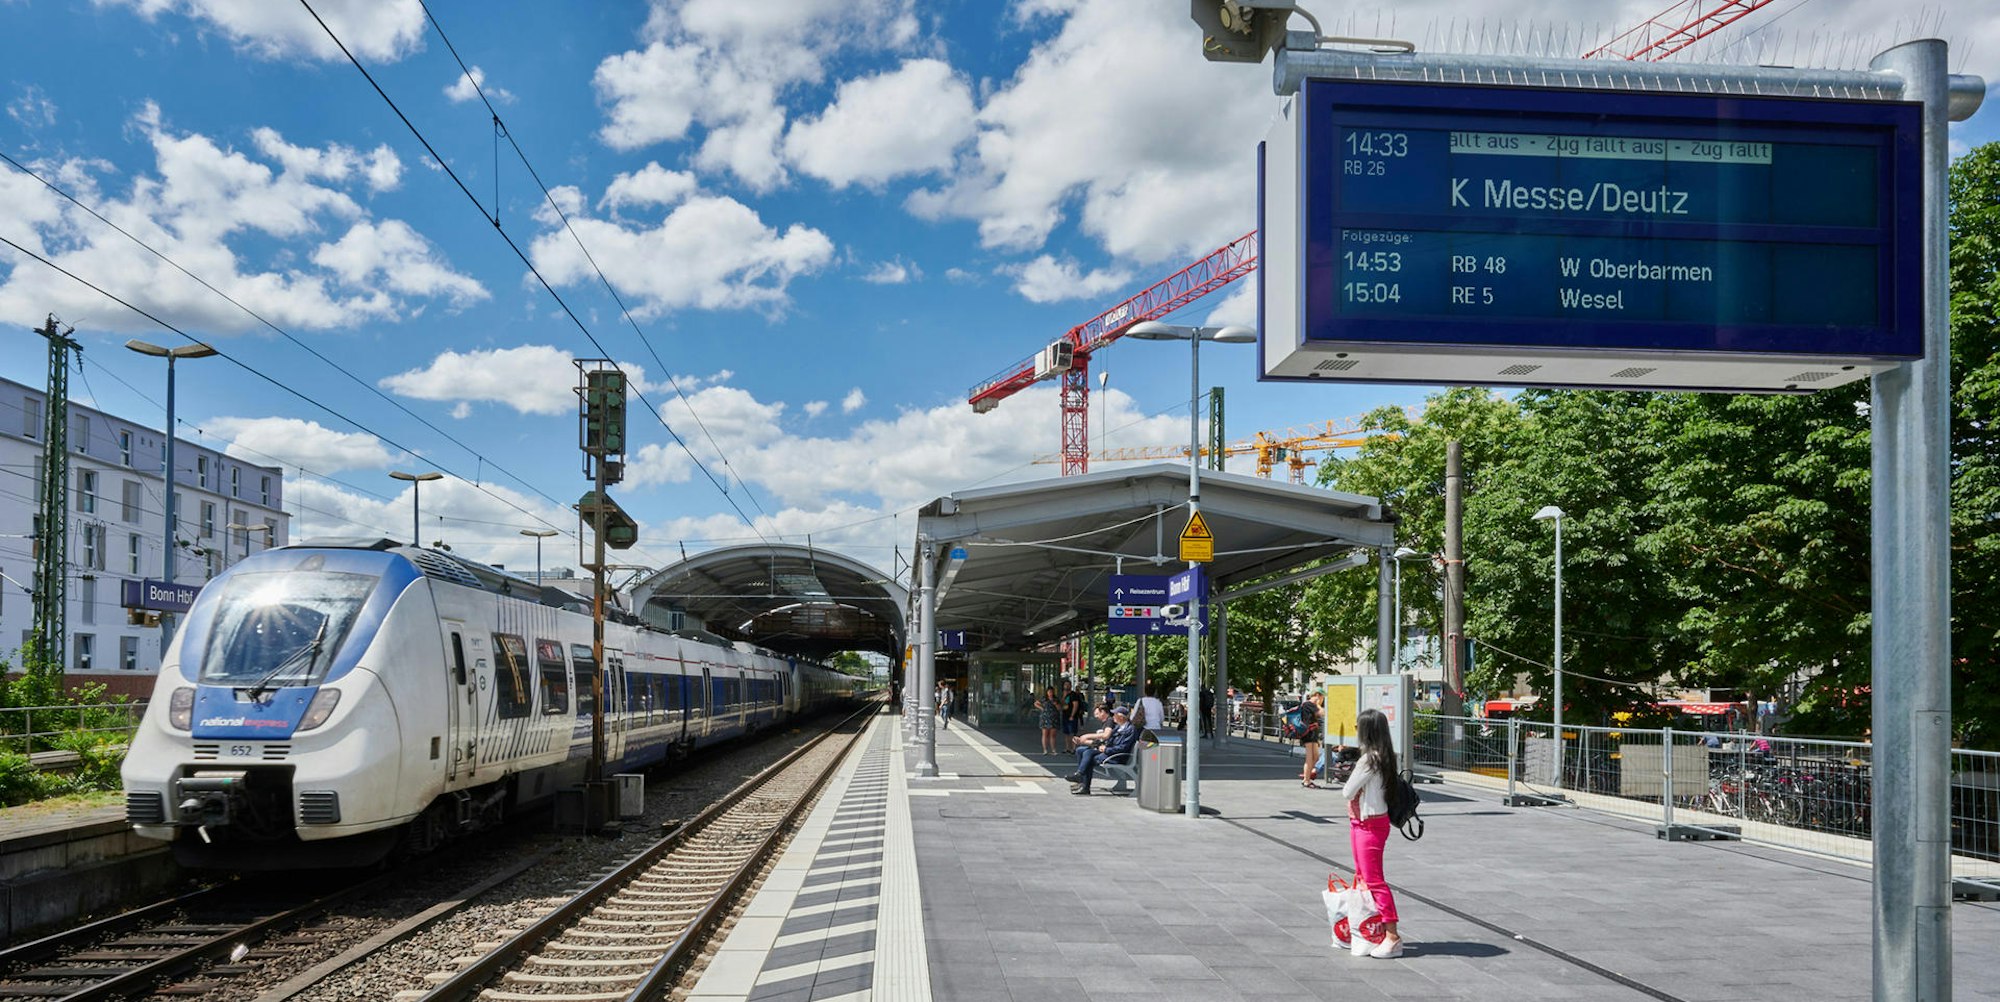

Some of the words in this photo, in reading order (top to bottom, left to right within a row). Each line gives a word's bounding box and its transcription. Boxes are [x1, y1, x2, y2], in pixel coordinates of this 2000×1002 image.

[1346, 131, 1408, 157] 14:33
[1488, 136, 1519, 149] aus
[1545, 136, 1579, 155] Zug
[1632, 141, 1664, 154] aus
[1691, 141, 1722, 160] Zug
[1344, 160, 1362, 175] RB
[1367, 161, 1385, 176] 26
[1452, 178, 1471, 207] K
[1484, 179, 1689, 215] Messe/Deutz
[1342, 229, 1413, 245] Folgezüge:
[1344, 251, 1401, 272] 14:53
[1453, 255, 1477, 273] RB
[1484, 256, 1506, 274] 48
[1560, 257, 1581, 278] W
[1590, 258, 1713, 282] Oberbarmen
[1344, 282, 1401, 303] 15:04
[1453, 286, 1476, 304] RE
[1483, 287, 1494, 305] 5
[1560, 288, 1624, 310] Wesel
[150, 585, 175, 603] Bonn
[177, 588, 194, 605] Hbf
[231, 745, 253, 756] 652
